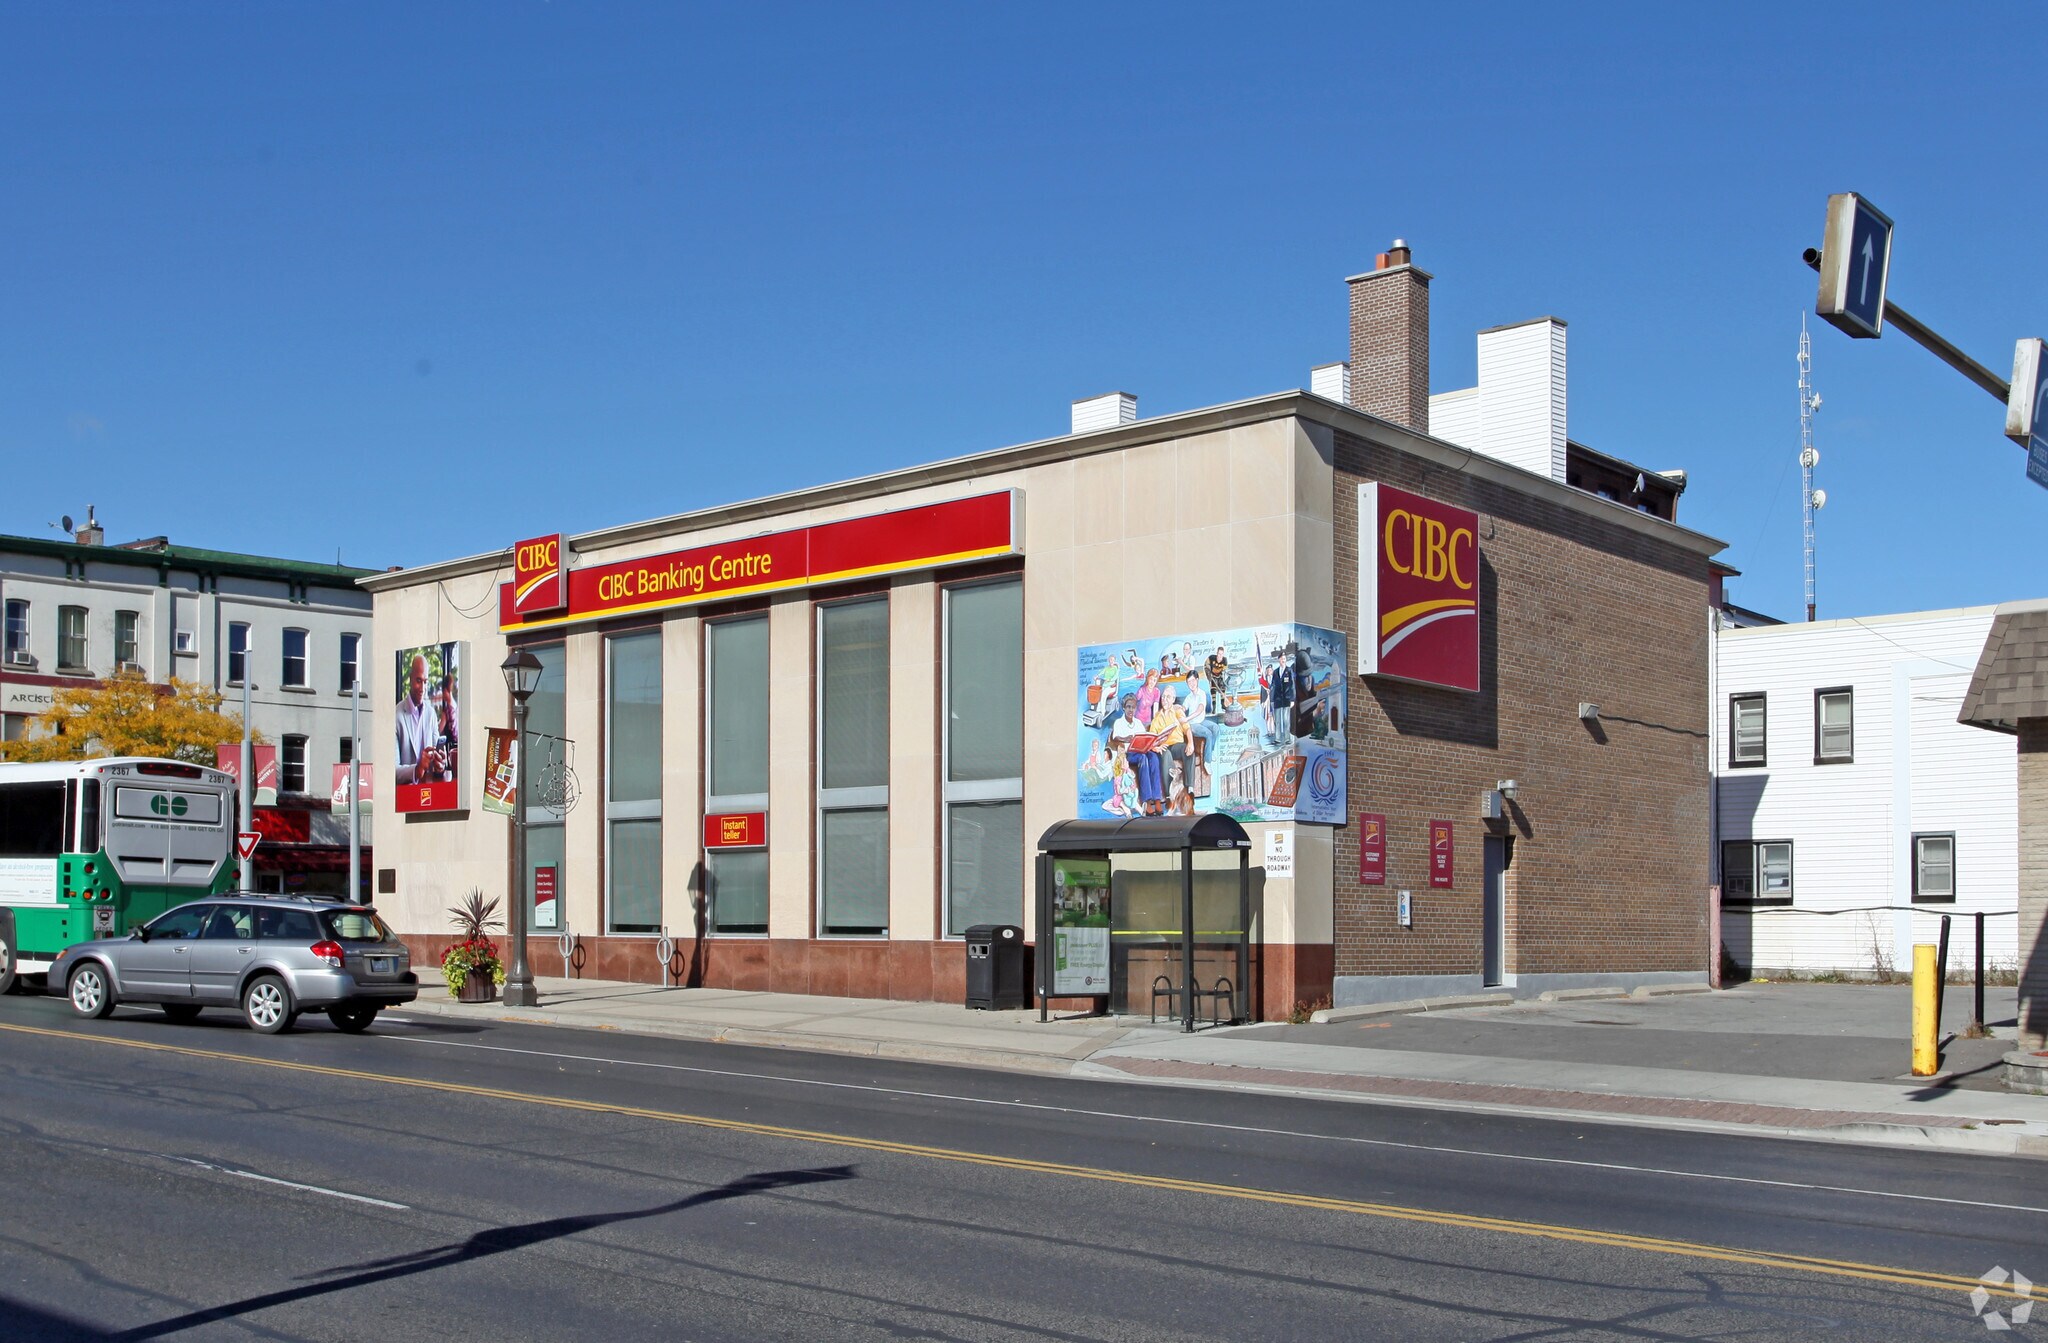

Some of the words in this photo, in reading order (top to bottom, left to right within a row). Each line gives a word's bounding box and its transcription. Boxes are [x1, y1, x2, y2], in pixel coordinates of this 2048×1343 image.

[517, 541, 557, 572] CIBC
[1385, 509, 1473, 590] CIBC
[599, 571, 634, 600] CIBC
[638, 562, 704, 592] Banking
[709, 552, 772, 581] Centre
[112, 767, 130, 776] 2367
[208, 775, 225, 783] 2367
[151, 795, 188, 816] GO
[724, 820, 745, 830] Instant
[724, 830, 740, 840] teller
